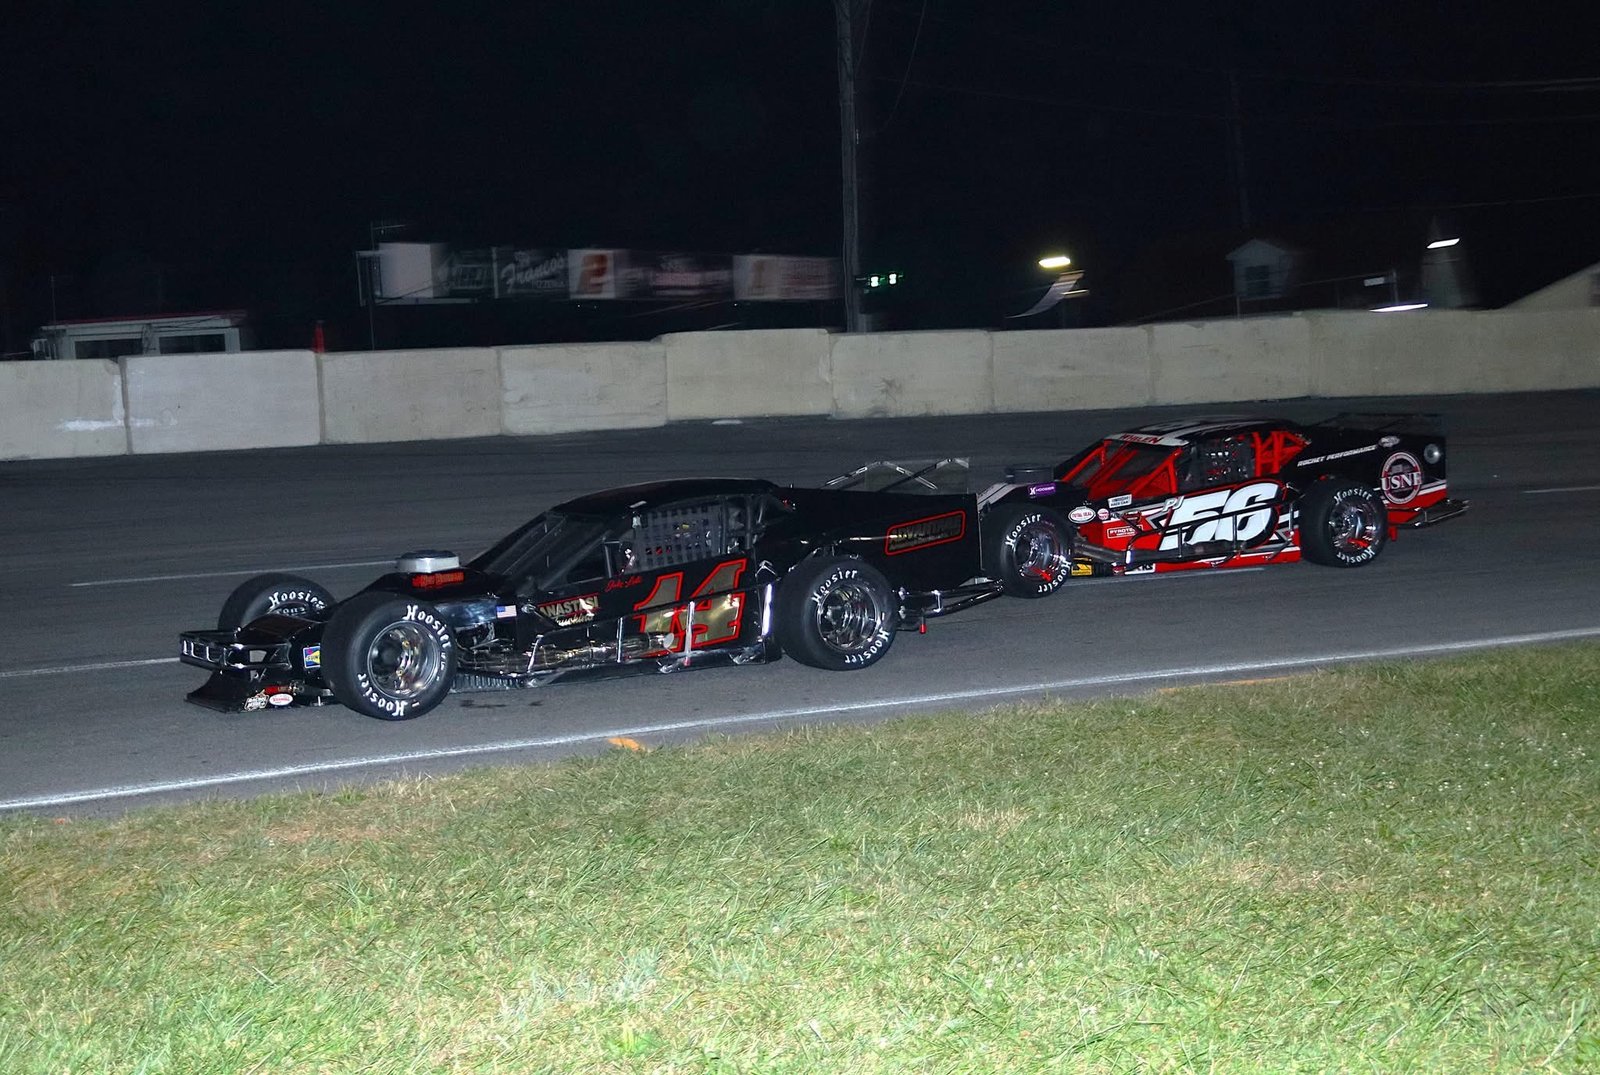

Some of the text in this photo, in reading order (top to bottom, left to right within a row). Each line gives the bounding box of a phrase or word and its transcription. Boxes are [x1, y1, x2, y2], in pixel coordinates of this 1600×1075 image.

[1326, 444, 1377, 461] PERFORMANCE
[1333, 487, 1373, 505] Hoosier
[1005, 514, 1041, 552] Hoosier
[1158, 482, 1279, 551] 56
[1037, 555, 1072, 593] Hoosier
[1336, 545, 1376, 566] Hoosier
[811, 567, 858, 605] Hoosier
[402, 605, 452, 648] Hoosier
[632, 558, 747, 659] 14
[844, 627, 889, 664] Hoosier
[358, 673, 408, 716] Hoosier
